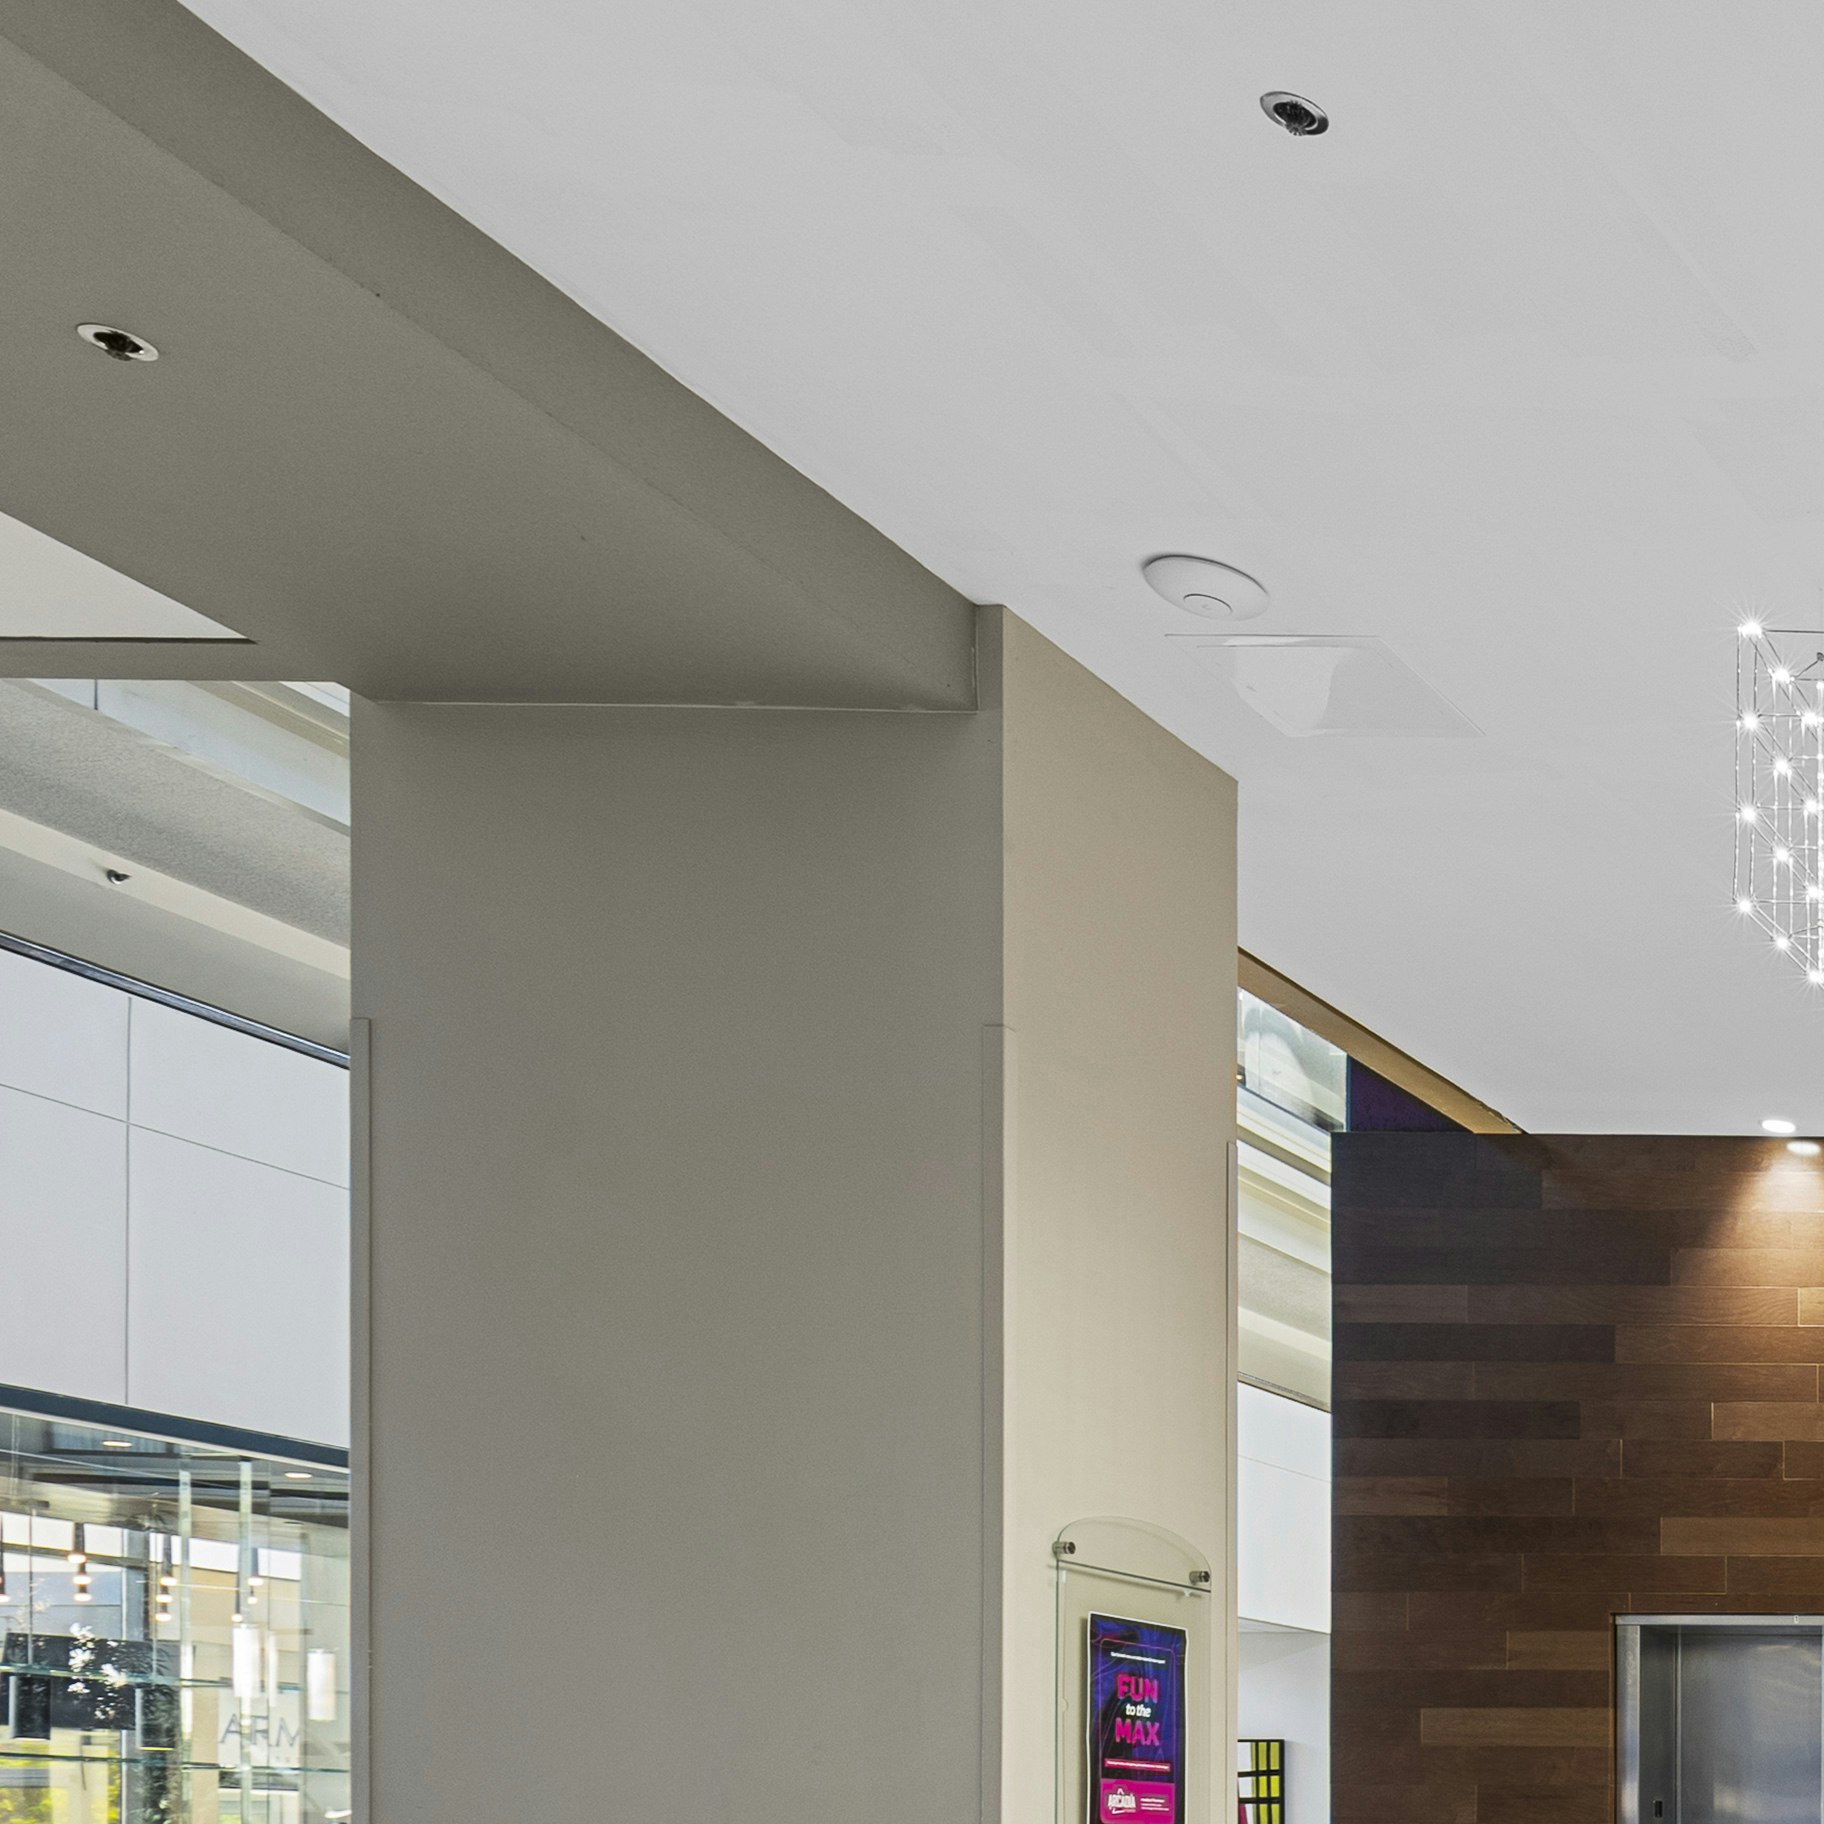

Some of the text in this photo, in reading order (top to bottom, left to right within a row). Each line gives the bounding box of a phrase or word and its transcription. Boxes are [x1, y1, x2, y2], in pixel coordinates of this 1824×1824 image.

[1117, 1674, 1158, 1703] FUN
[1126, 1703, 1152, 1718] to the
[1115, 1717, 1160, 1746] MAX
